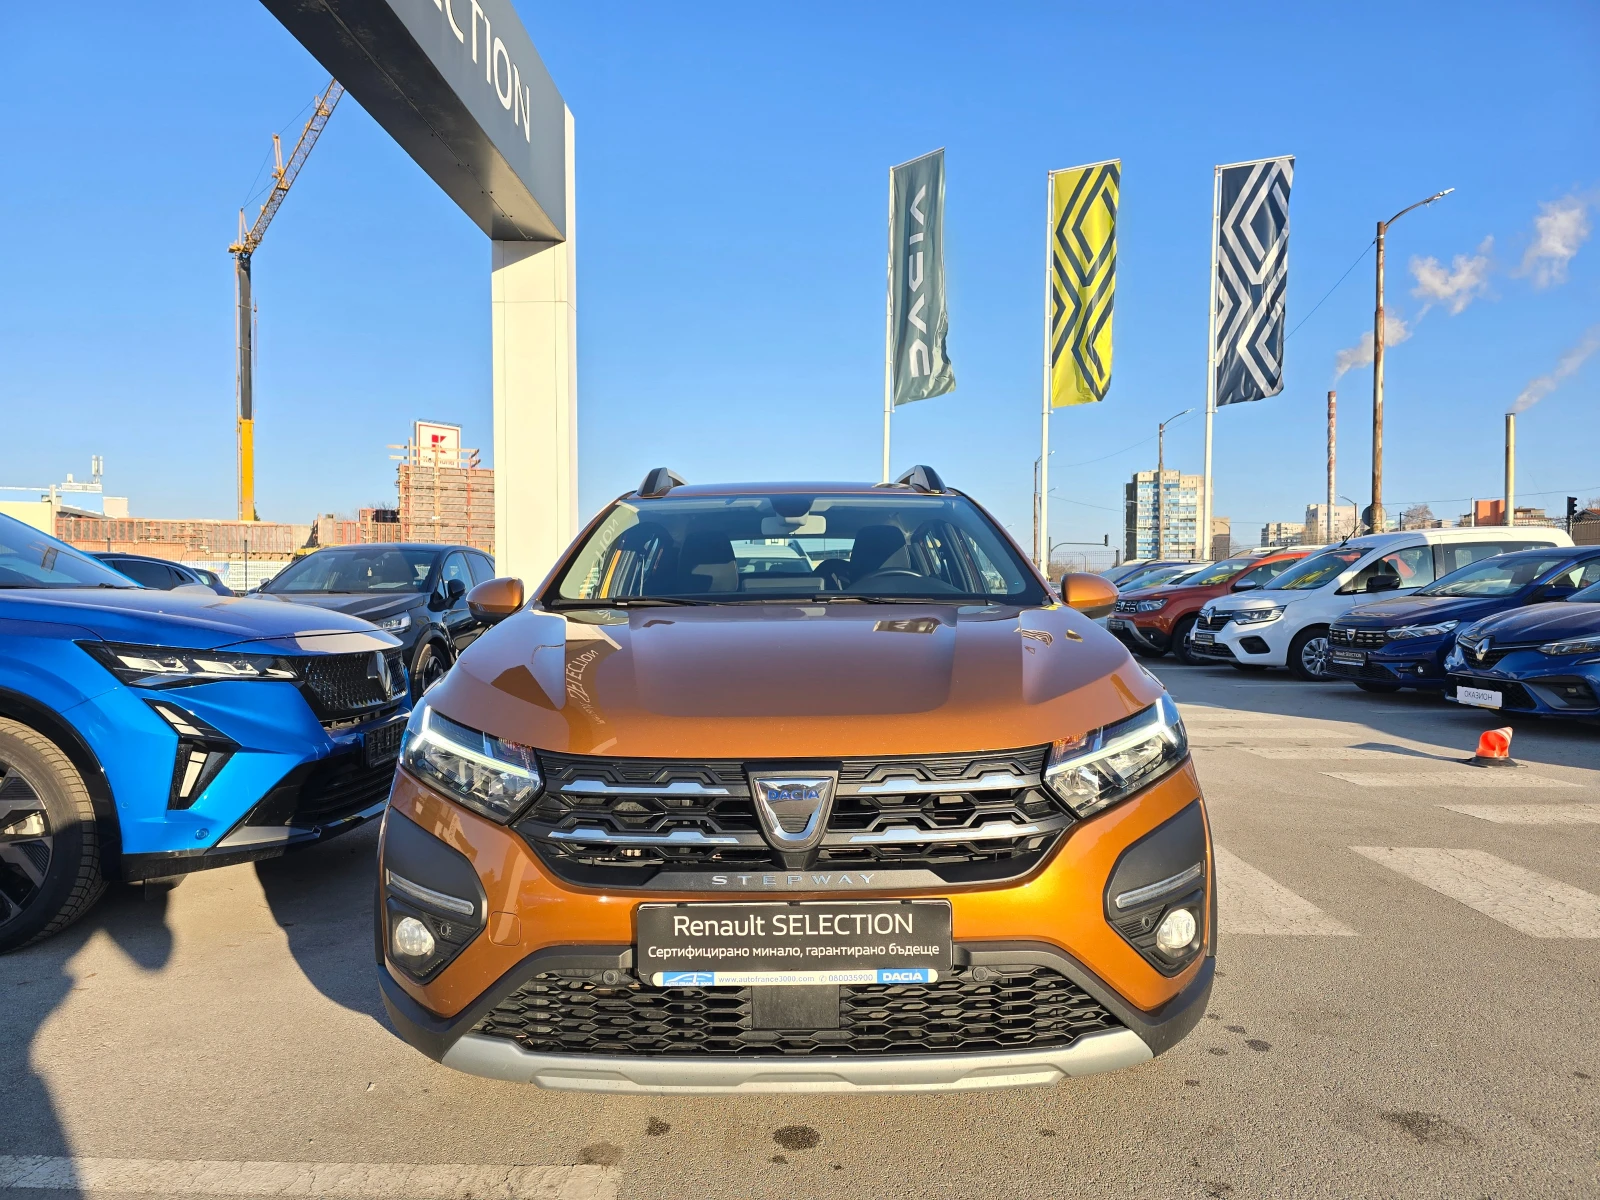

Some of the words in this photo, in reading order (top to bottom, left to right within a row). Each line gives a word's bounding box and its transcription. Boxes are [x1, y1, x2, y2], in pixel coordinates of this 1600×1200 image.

[908, 184, 931, 378] DACIA
[1464, 690, 1493, 701] ОКАЗИОН
[767, 789, 820, 801] DACIA
[711, 873, 875, 885] STEPWAY
[673, 914, 766, 936] Renault
[772, 913, 913, 936] SELECTION
[648, 945, 750, 960] Сертифицирано
[753, 946, 803, 958] минало,
[806, 945, 886, 959] гарантирано
[888, 943, 940, 956] бъдеще
[719, 974, 815, 984] www.autofrance3000.com
[828, 973, 874, 982] 080035900
[882, 972, 923, 981] DACIA
